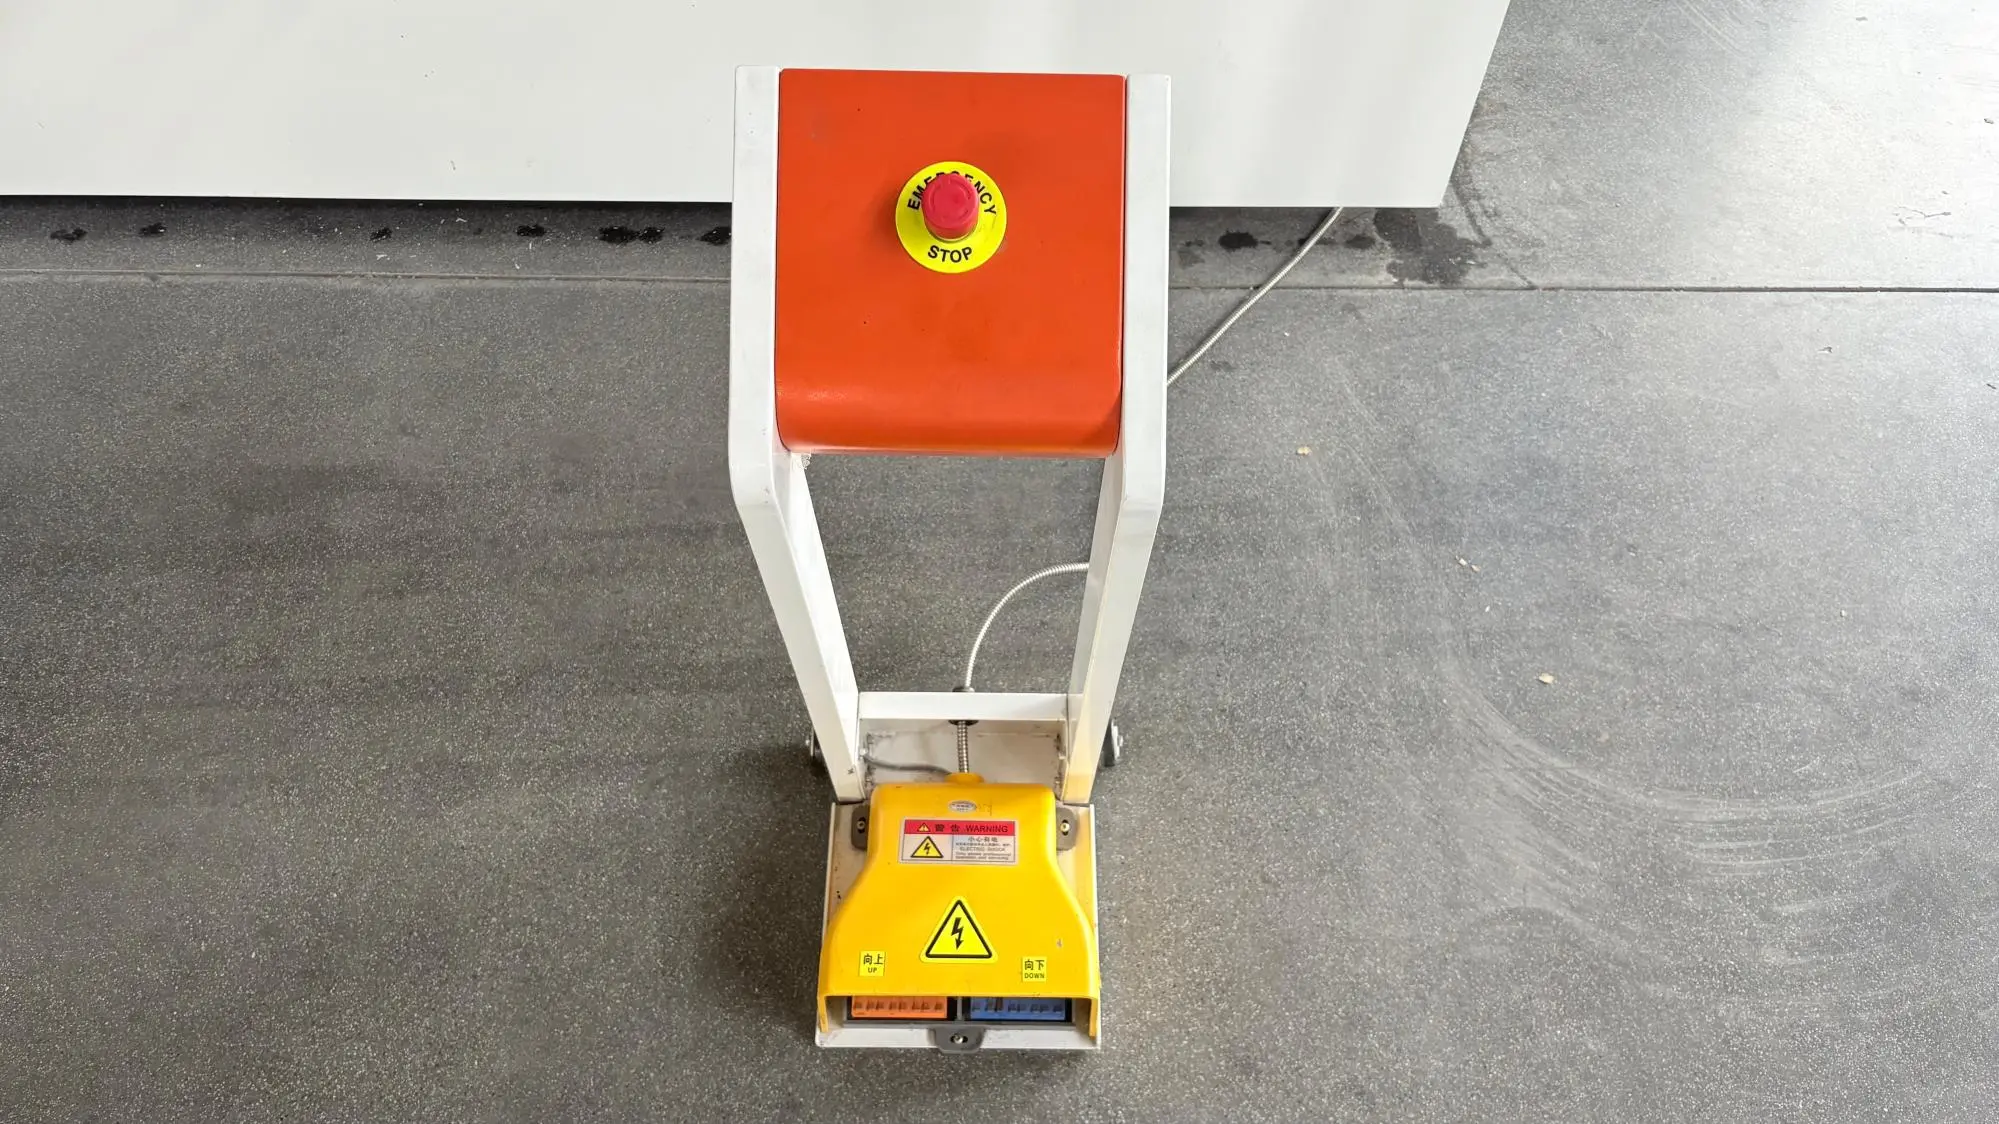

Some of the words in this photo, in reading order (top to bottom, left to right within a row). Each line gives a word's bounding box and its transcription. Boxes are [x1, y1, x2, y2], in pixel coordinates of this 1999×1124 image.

[907, 171, 997, 215] EMNCY
[928, 245, 972, 263] STOP
[965, 824, 1009, 833] WARNING
[863, 953, 883, 965] 向上
[1024, 959, 1045, 970] 向下
